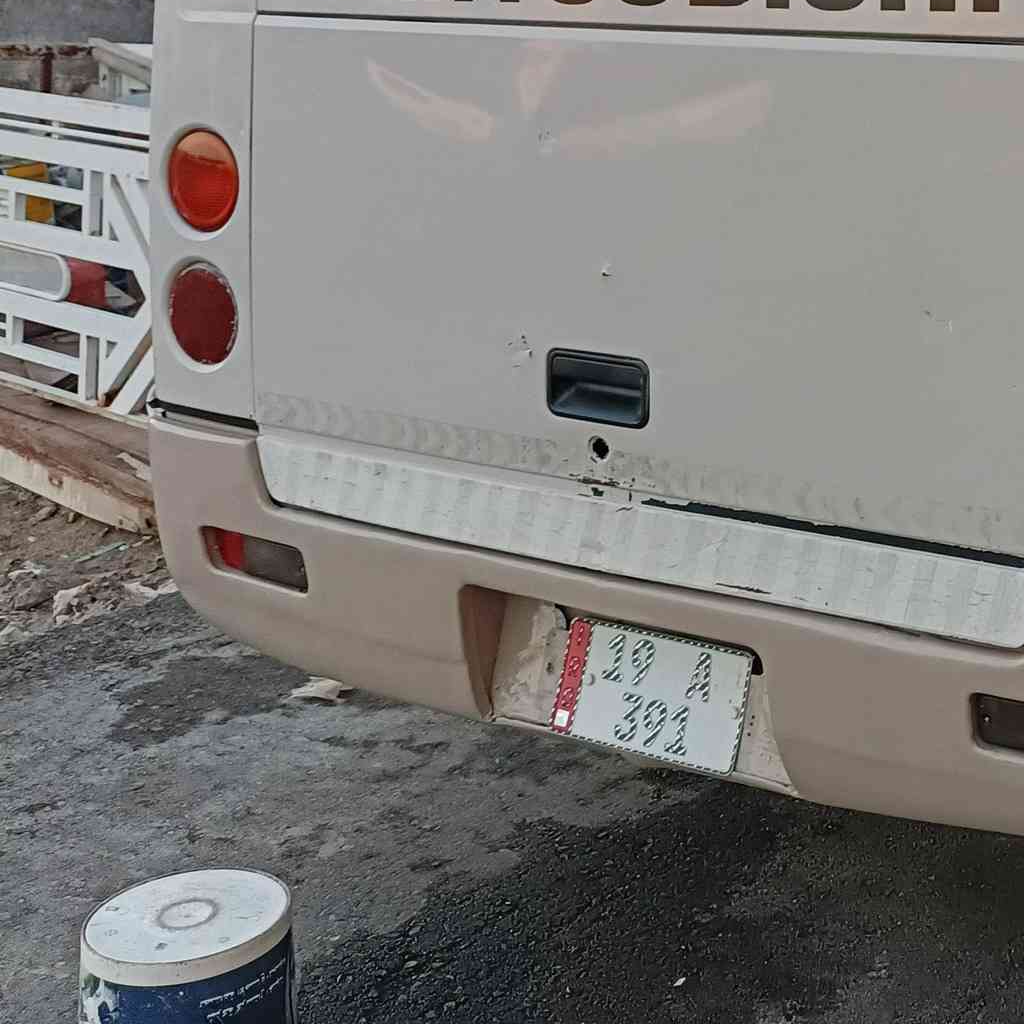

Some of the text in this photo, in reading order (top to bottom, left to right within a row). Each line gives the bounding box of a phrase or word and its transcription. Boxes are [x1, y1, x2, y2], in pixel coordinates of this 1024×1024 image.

[601, 633, 713, 702] 19 A
[613, 691, 690, 757] 391
